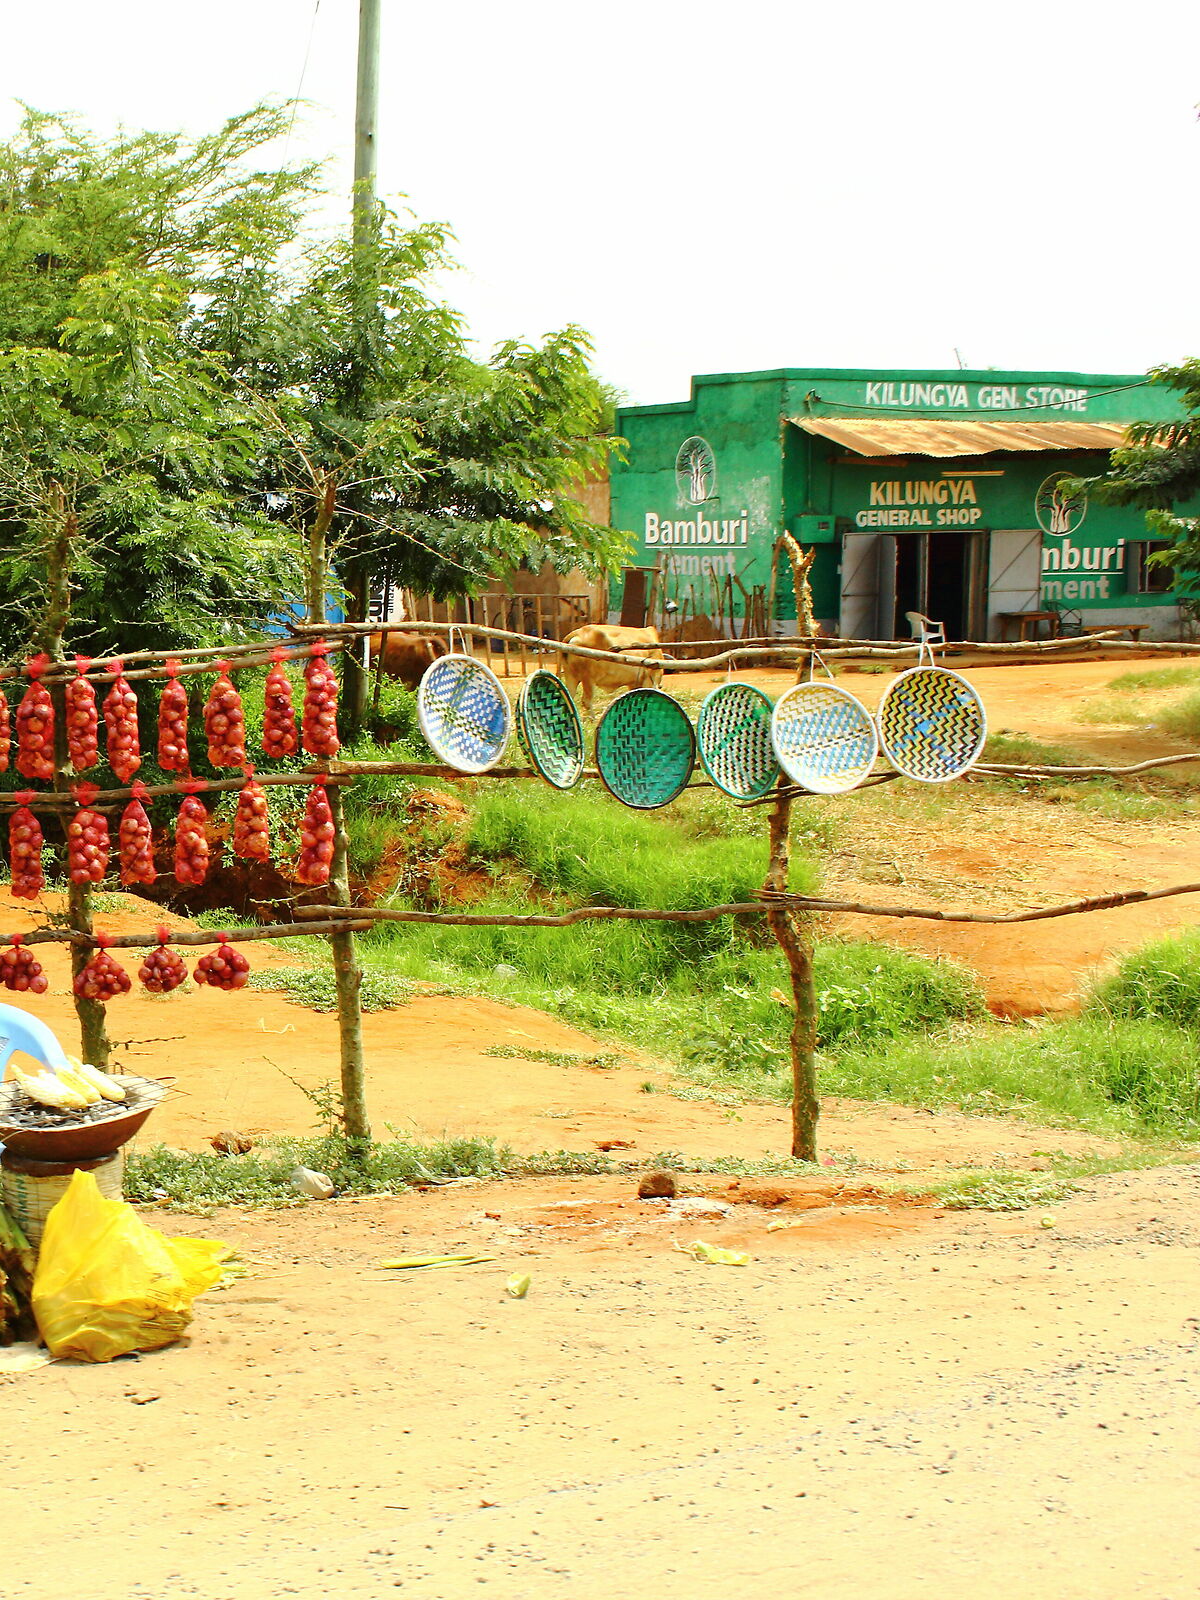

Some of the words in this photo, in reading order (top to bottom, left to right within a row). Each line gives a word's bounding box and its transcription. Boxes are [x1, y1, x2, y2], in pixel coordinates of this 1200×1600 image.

[865, 382, 969, 408] KILUNGYA
[977, 386, 1020, 409] GEN.
[1025, 387, 1089, 412] STORE
[869, 480, 977, 506] KILUNGYA
[645, 509, 749, 545] Bamburi
[855, 509, 933, 527] GENERAL
[936, 508, 982, 525] SHOP
